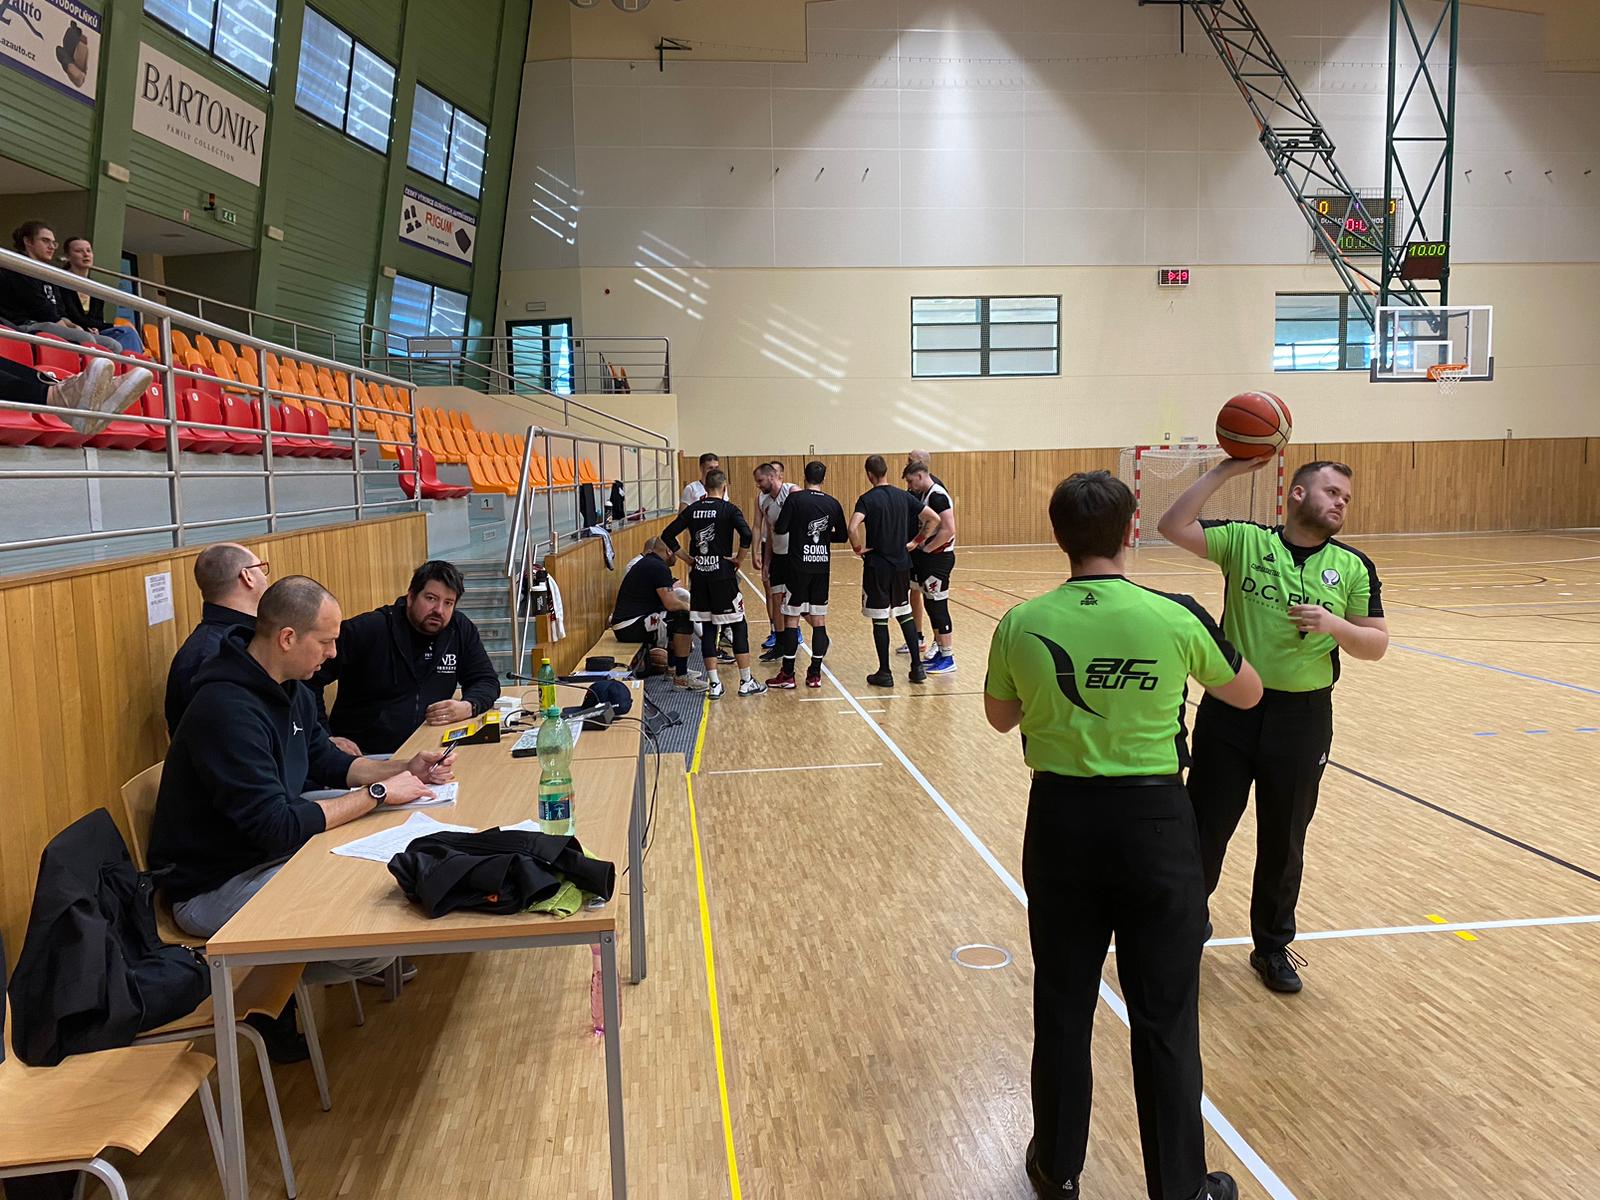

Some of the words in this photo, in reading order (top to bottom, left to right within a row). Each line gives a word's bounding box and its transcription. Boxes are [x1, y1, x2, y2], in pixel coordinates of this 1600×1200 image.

[142, 62, 259, 155] BARTONIK
[166, 124, 191, 141] FAMILY
[194, 137, 235, 162] COLLECTION
[1319, 200, 1329, 215] 0
[425, 212, 453, 234] RIGUM
[1408, 244, 1446, 257] 10.00
[483, 498, 489, 508] 1
[693, 510, 717, 519] LITTER
[803, 544, 828, 555] SOKOL
[1241, 576, 1280, 603] D.C.
